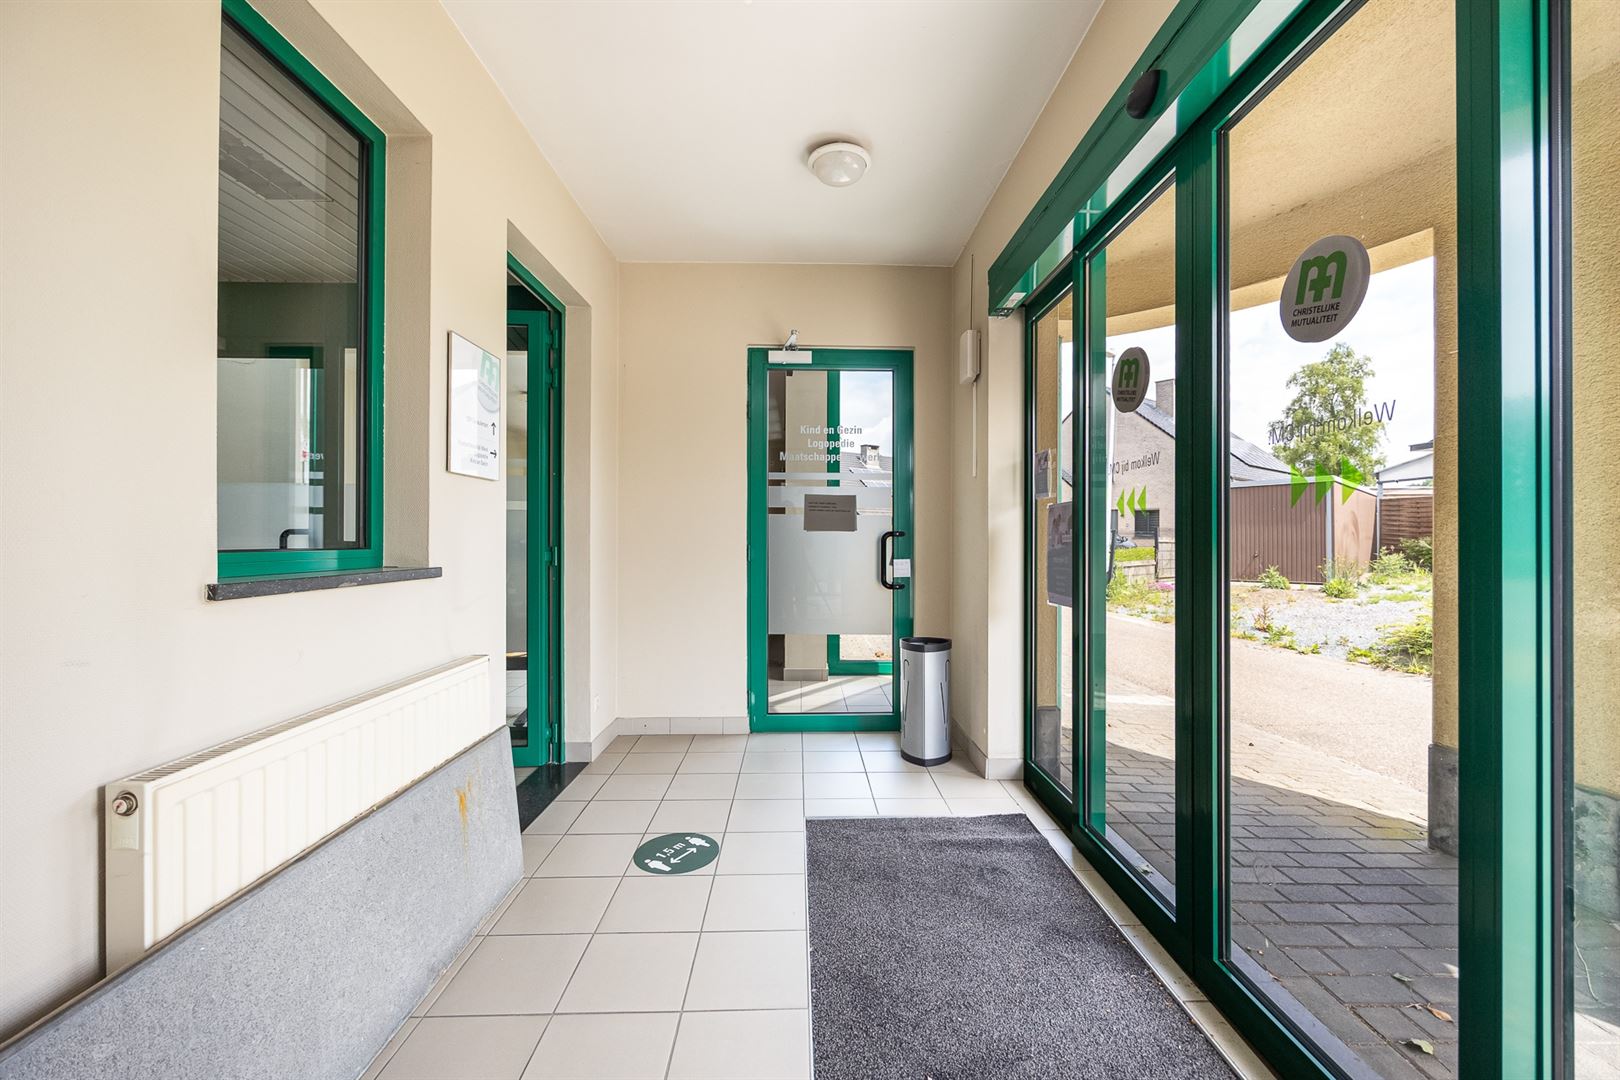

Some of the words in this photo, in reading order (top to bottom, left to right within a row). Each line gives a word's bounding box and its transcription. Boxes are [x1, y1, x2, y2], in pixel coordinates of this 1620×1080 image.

[1292, 301, 1341, 317] CHRISTELIJKE
[1290, 313, 1338, 328] MUTUALITEIT
[800, 425, 820, 435] Kind
[823, 427, 835, 435] en
[837, 425, 863, 435] Gezin
[807, 438, 855, 450] Logopedie
